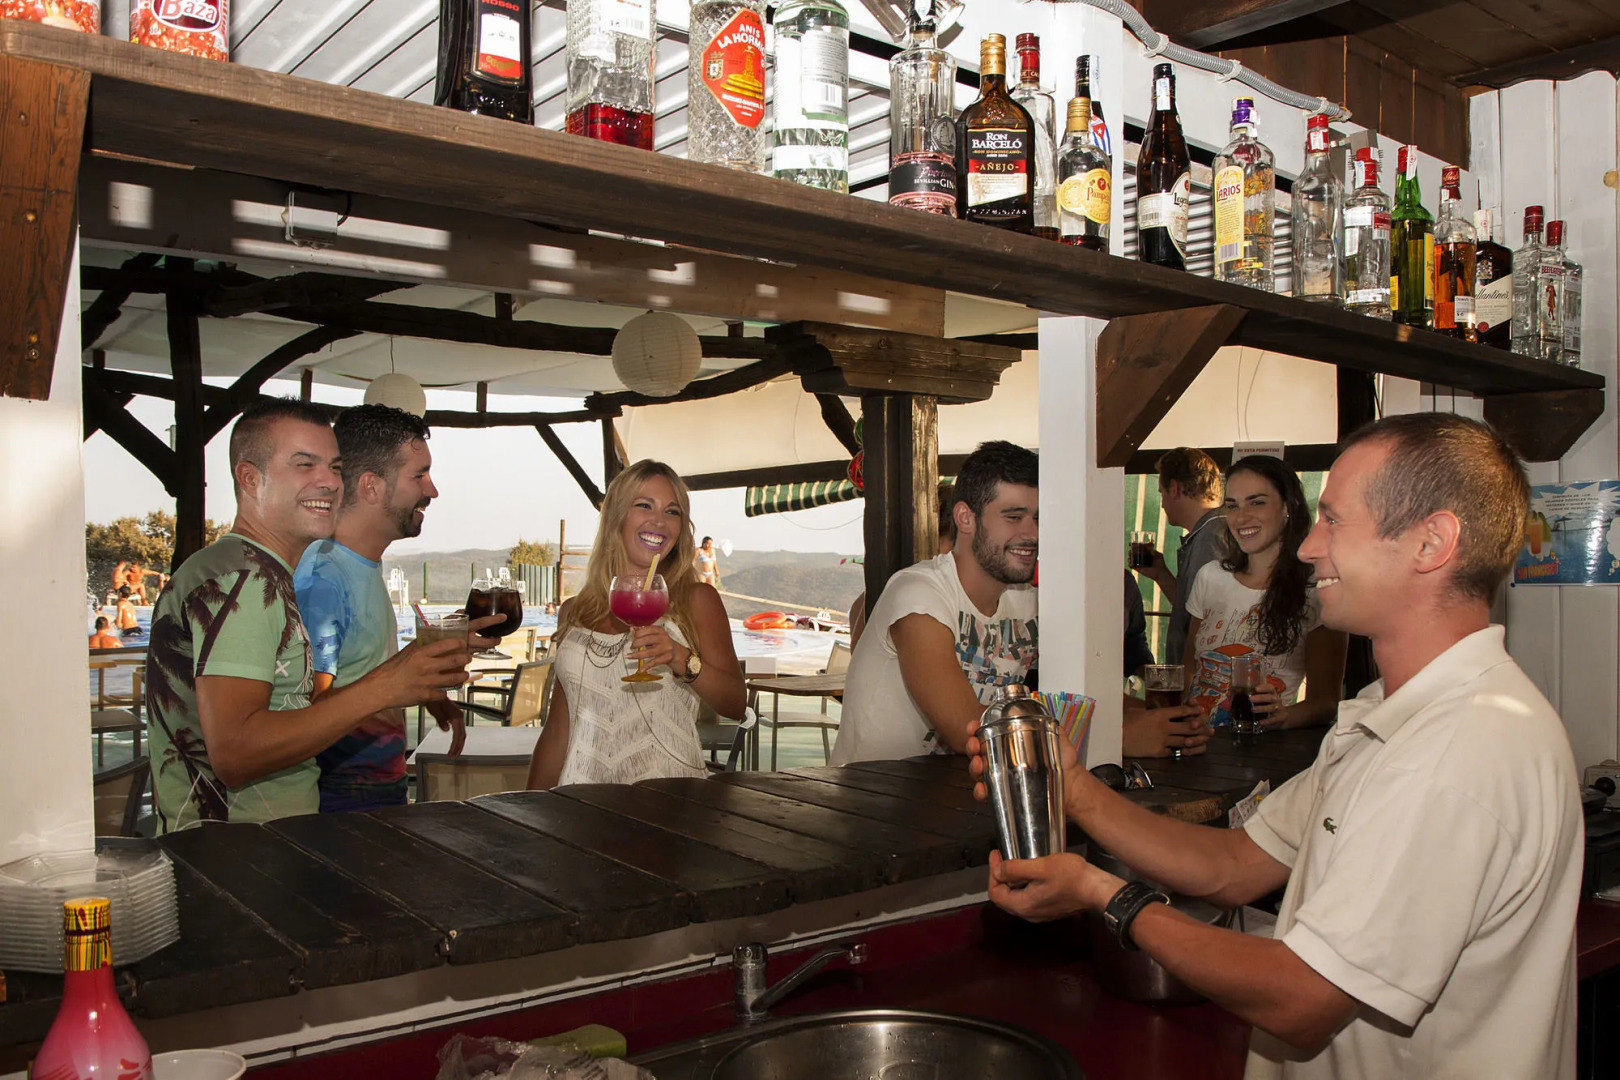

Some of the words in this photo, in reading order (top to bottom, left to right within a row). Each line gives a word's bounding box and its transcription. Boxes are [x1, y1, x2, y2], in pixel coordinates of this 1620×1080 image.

[161, 0, 215, 23] Baza
[739, 23, 761, 38] ANIS
[716, 34, 733, 50] LA
[972, 138, 1023, 149] BARCELÓ
[985, 132, 1009, 141] RON
[1216, 184, 1242, 202] LARIOS
[1475, 287, 1509, 300] llantine's
